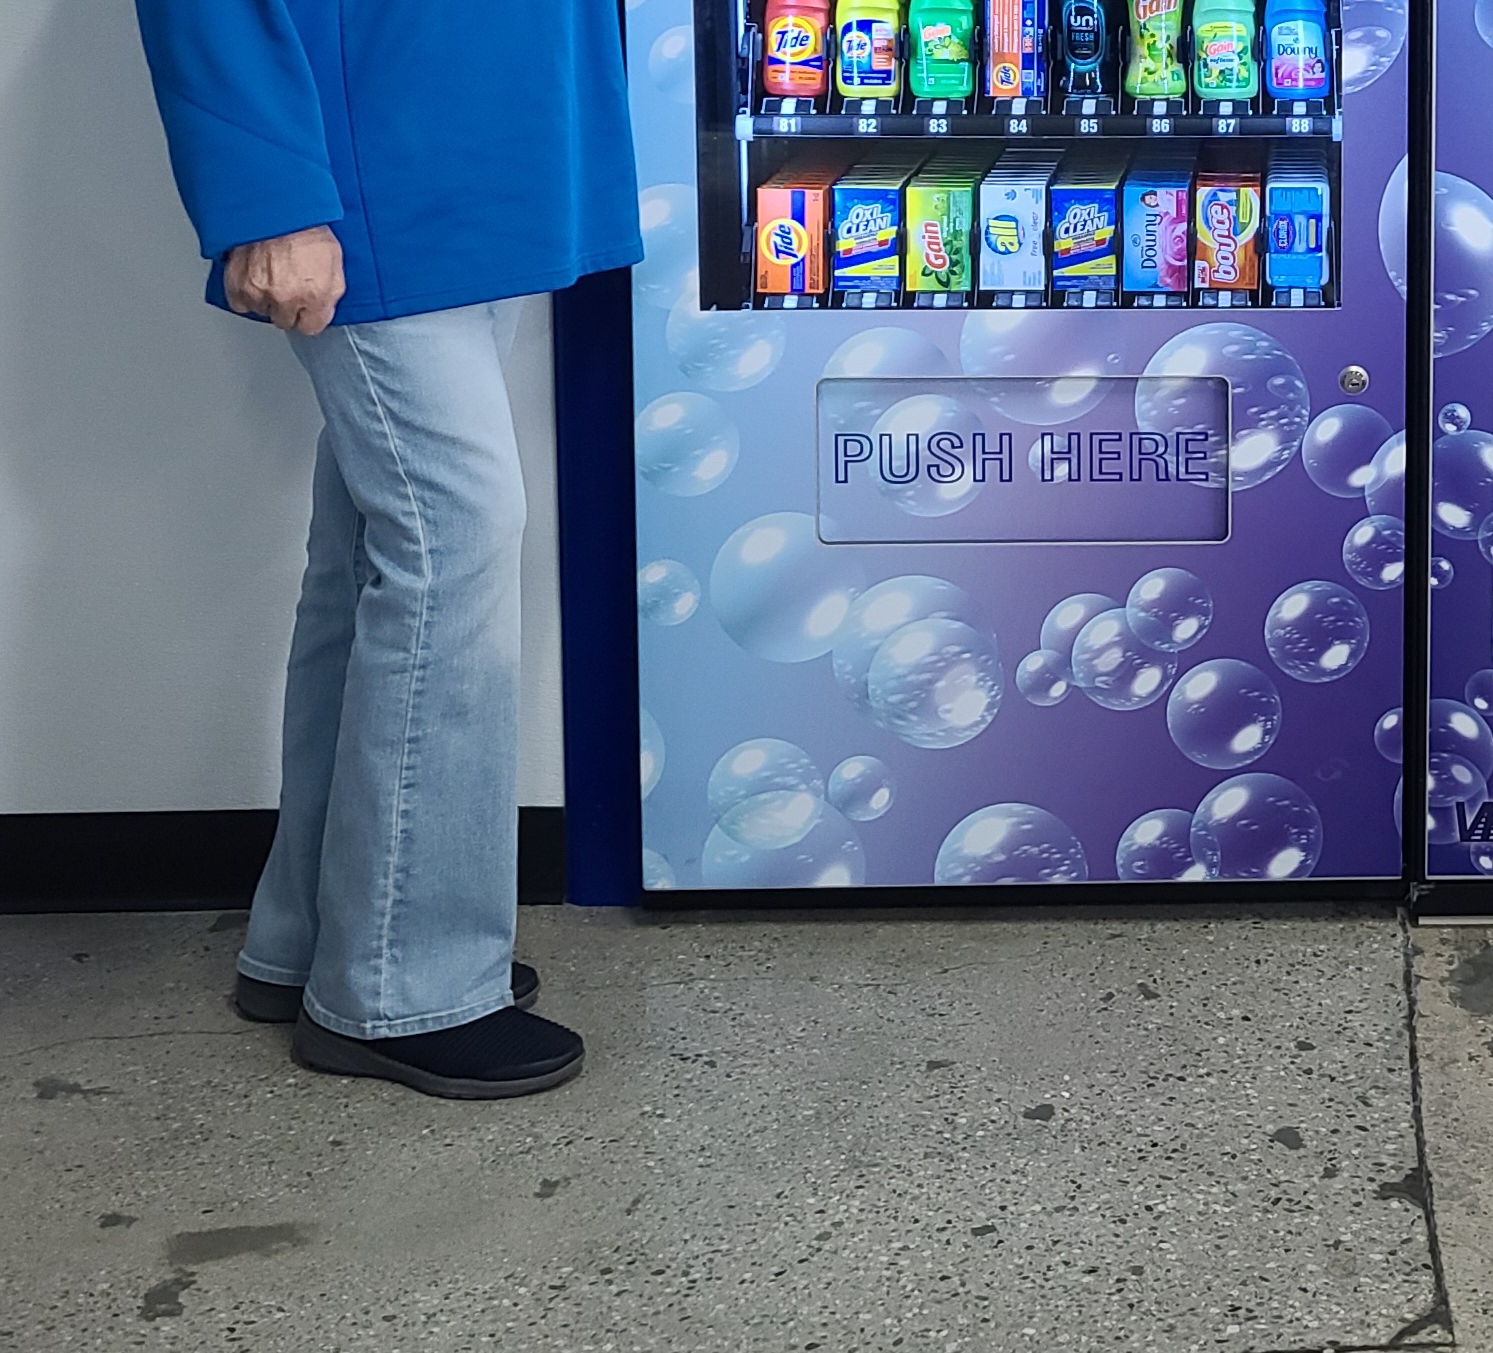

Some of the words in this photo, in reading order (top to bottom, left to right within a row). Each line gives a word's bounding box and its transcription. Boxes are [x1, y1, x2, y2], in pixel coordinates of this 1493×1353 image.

[775, 29, 811, 53] Tide
[1072, 32, 1094, 42] FRESH
[846, 39, 867, 54] Tde
[1208, 42, 1234, 56] Gain
[779, 119, 796, 132] 81
[858, 120, 877, 132] 82
[929, 120, 948, 132] 83
[1009, 120, 1028, 132] 84
[1080, 120, 1098, 132] 85
[1152, 120, 1170, 132] 86
[1218, 120, 1235, 132] 87
[1292, 120, 1308, 132] 88
[851, 205, 880, 224] OXI
[1068, 205, 1097, 224] OXI
[842, 215, 889, 239] CLEAN
[988, 218, 1020, 253] all
[1059, 215, 1106, 240] CLEAN
[773, 224, 798, 260] Tide
[922, 222, 949, 270] Gain
[1141, 214, 1163, 269] Downy
[1211, 202, 1238, 281] bounce
[833, 432, 1013, 484] PUSH
[1030, 431, 1210, 482] HERE
